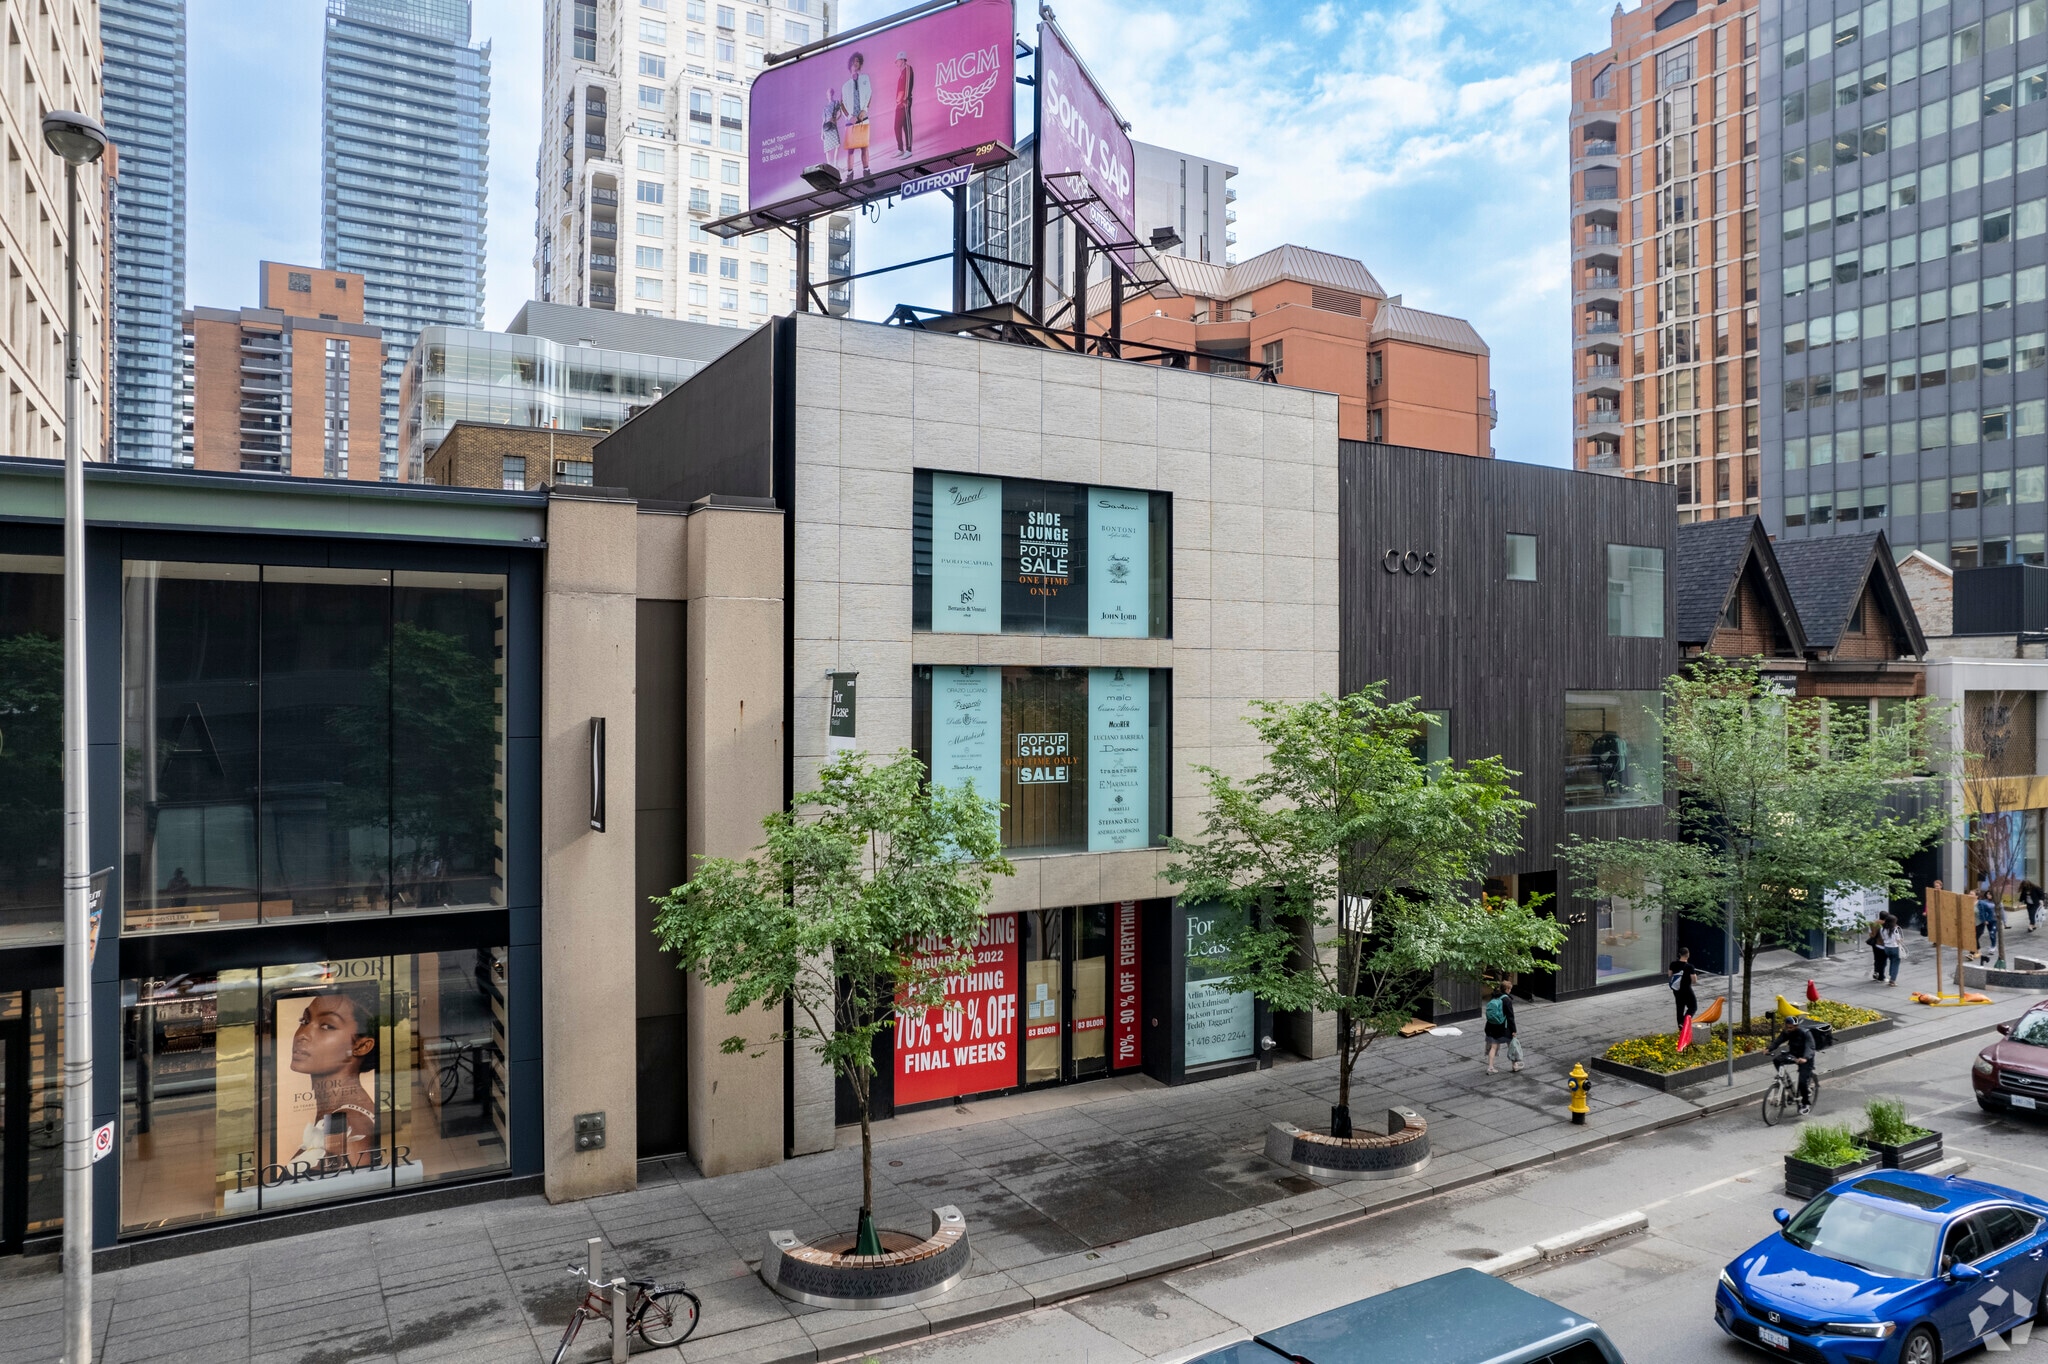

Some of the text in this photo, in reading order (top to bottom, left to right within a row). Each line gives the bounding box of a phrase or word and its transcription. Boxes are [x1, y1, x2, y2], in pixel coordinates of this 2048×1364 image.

[934, 44, 1000, 88] MCM
[762, 132, 796, 147] MCM Toronto
[1046, 69, 1131, 201] Sorry SAP
[761, 144, 784, 155] Flagship
[762, 155, 770, 163] 93
[770, 152, 783, 161] Bloor
[902, 168, 967, 197] OUTFRONT
[1090, 206, 1118, 241] OUTFRONT
[1028, 511, 1061, 527] SHOE
[954, 531, 981, 542] DAMI
[1020, 525, 1069, 542] LOUNGE
[1101, 525, 1136, 534] BONTONI
[1020, 545, 1069, 559] POP-UP
[1020, 556, 1069, 575] SALE
[1382, 548, 1438, 577] COS
[1018, 575, 1069, 586] ONE TIME
[1029, 587, 1059, 597] ONLY
[833, 690, 844, 704] For
[832, 704, 850, 718] Lease
[1020, 735, 1066, 746] POP-UP
[1020, 745, 1066, 757] SHOP
[1005, 756, 1079, 766] ONE TIME ONLY
[1020, 766, 1066, 782] SALE
[1119, 899, 1136, 966] EVERYTHING
[1186, 916, 1215, 937] For
[977, 949, 1005, 964] 2022
[325, 958, 387, 979] DIOR
[1119, 971, 1136, 993] OFF
[1119, 994, 1136, 1008] %
[1187, 1001, 1202, 1011] Alex
[895, 1003, 931, 1050] 70%
[967, 997, 983, 1041] %
[987, 993, 1016, 1038] OFF
[1119, 1009, 1136, 1025] 90
[1187, 1009, 1211, 1021] Jackson
[1086, 1018, 1104, 1028] BLOOR
[1187, 1020, 1206, 1031] Teddy
[1028, 1025, 1056, 1037] 83 BLOOR
[1186, 1030, 1246, 1048] +1 416 362 2244
[1119, 1034, 1136, 1061] 70%
[904, 1040, 1006, 1075] FINAL WEEKS
[294, 1085, 359, 1103] FOREVER
[234, 1144, 415, 1194] FOREVER
